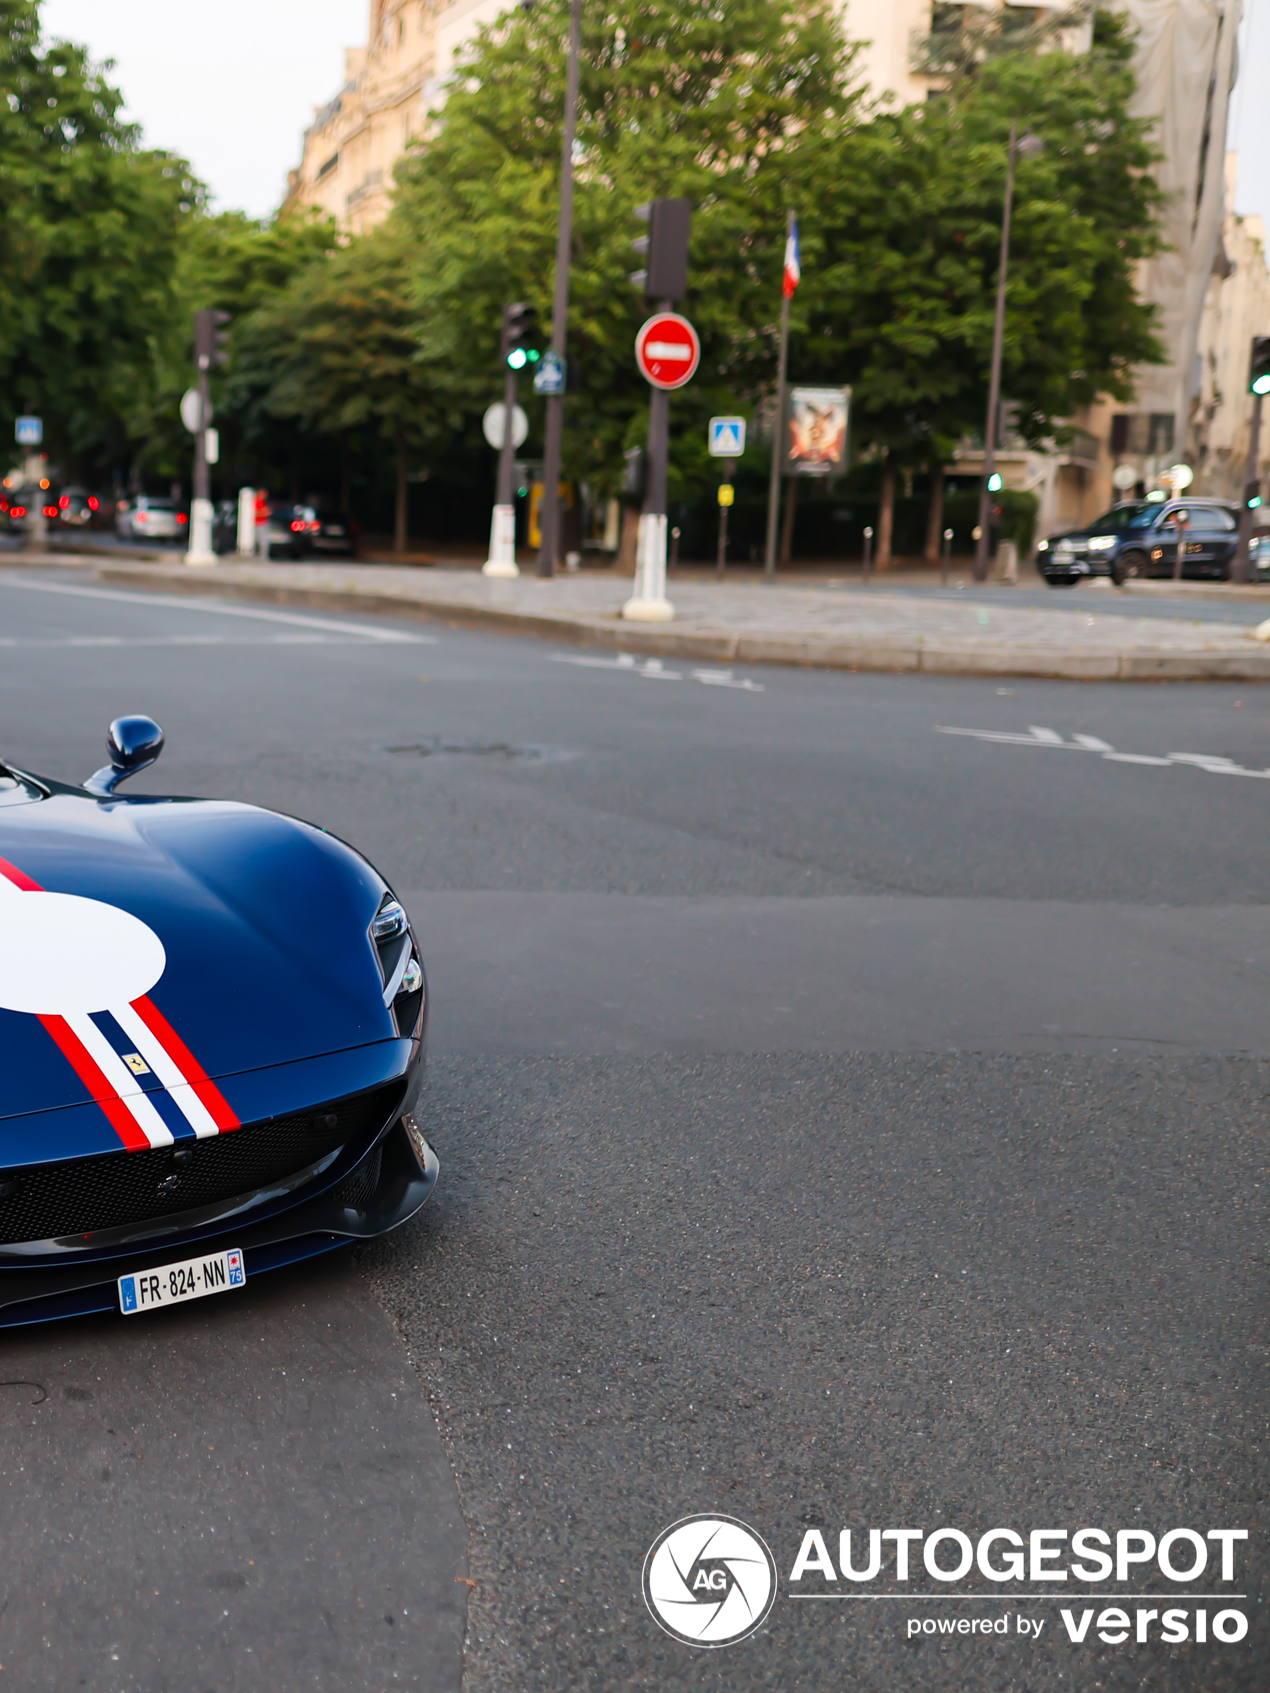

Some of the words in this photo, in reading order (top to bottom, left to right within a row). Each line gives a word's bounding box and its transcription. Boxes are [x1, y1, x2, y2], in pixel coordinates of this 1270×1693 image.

[139, 1258, 226, 1305] FR-824-NN
[230, 1269, 242, 1283] 75
[125, 1295, 133, 1307] F
